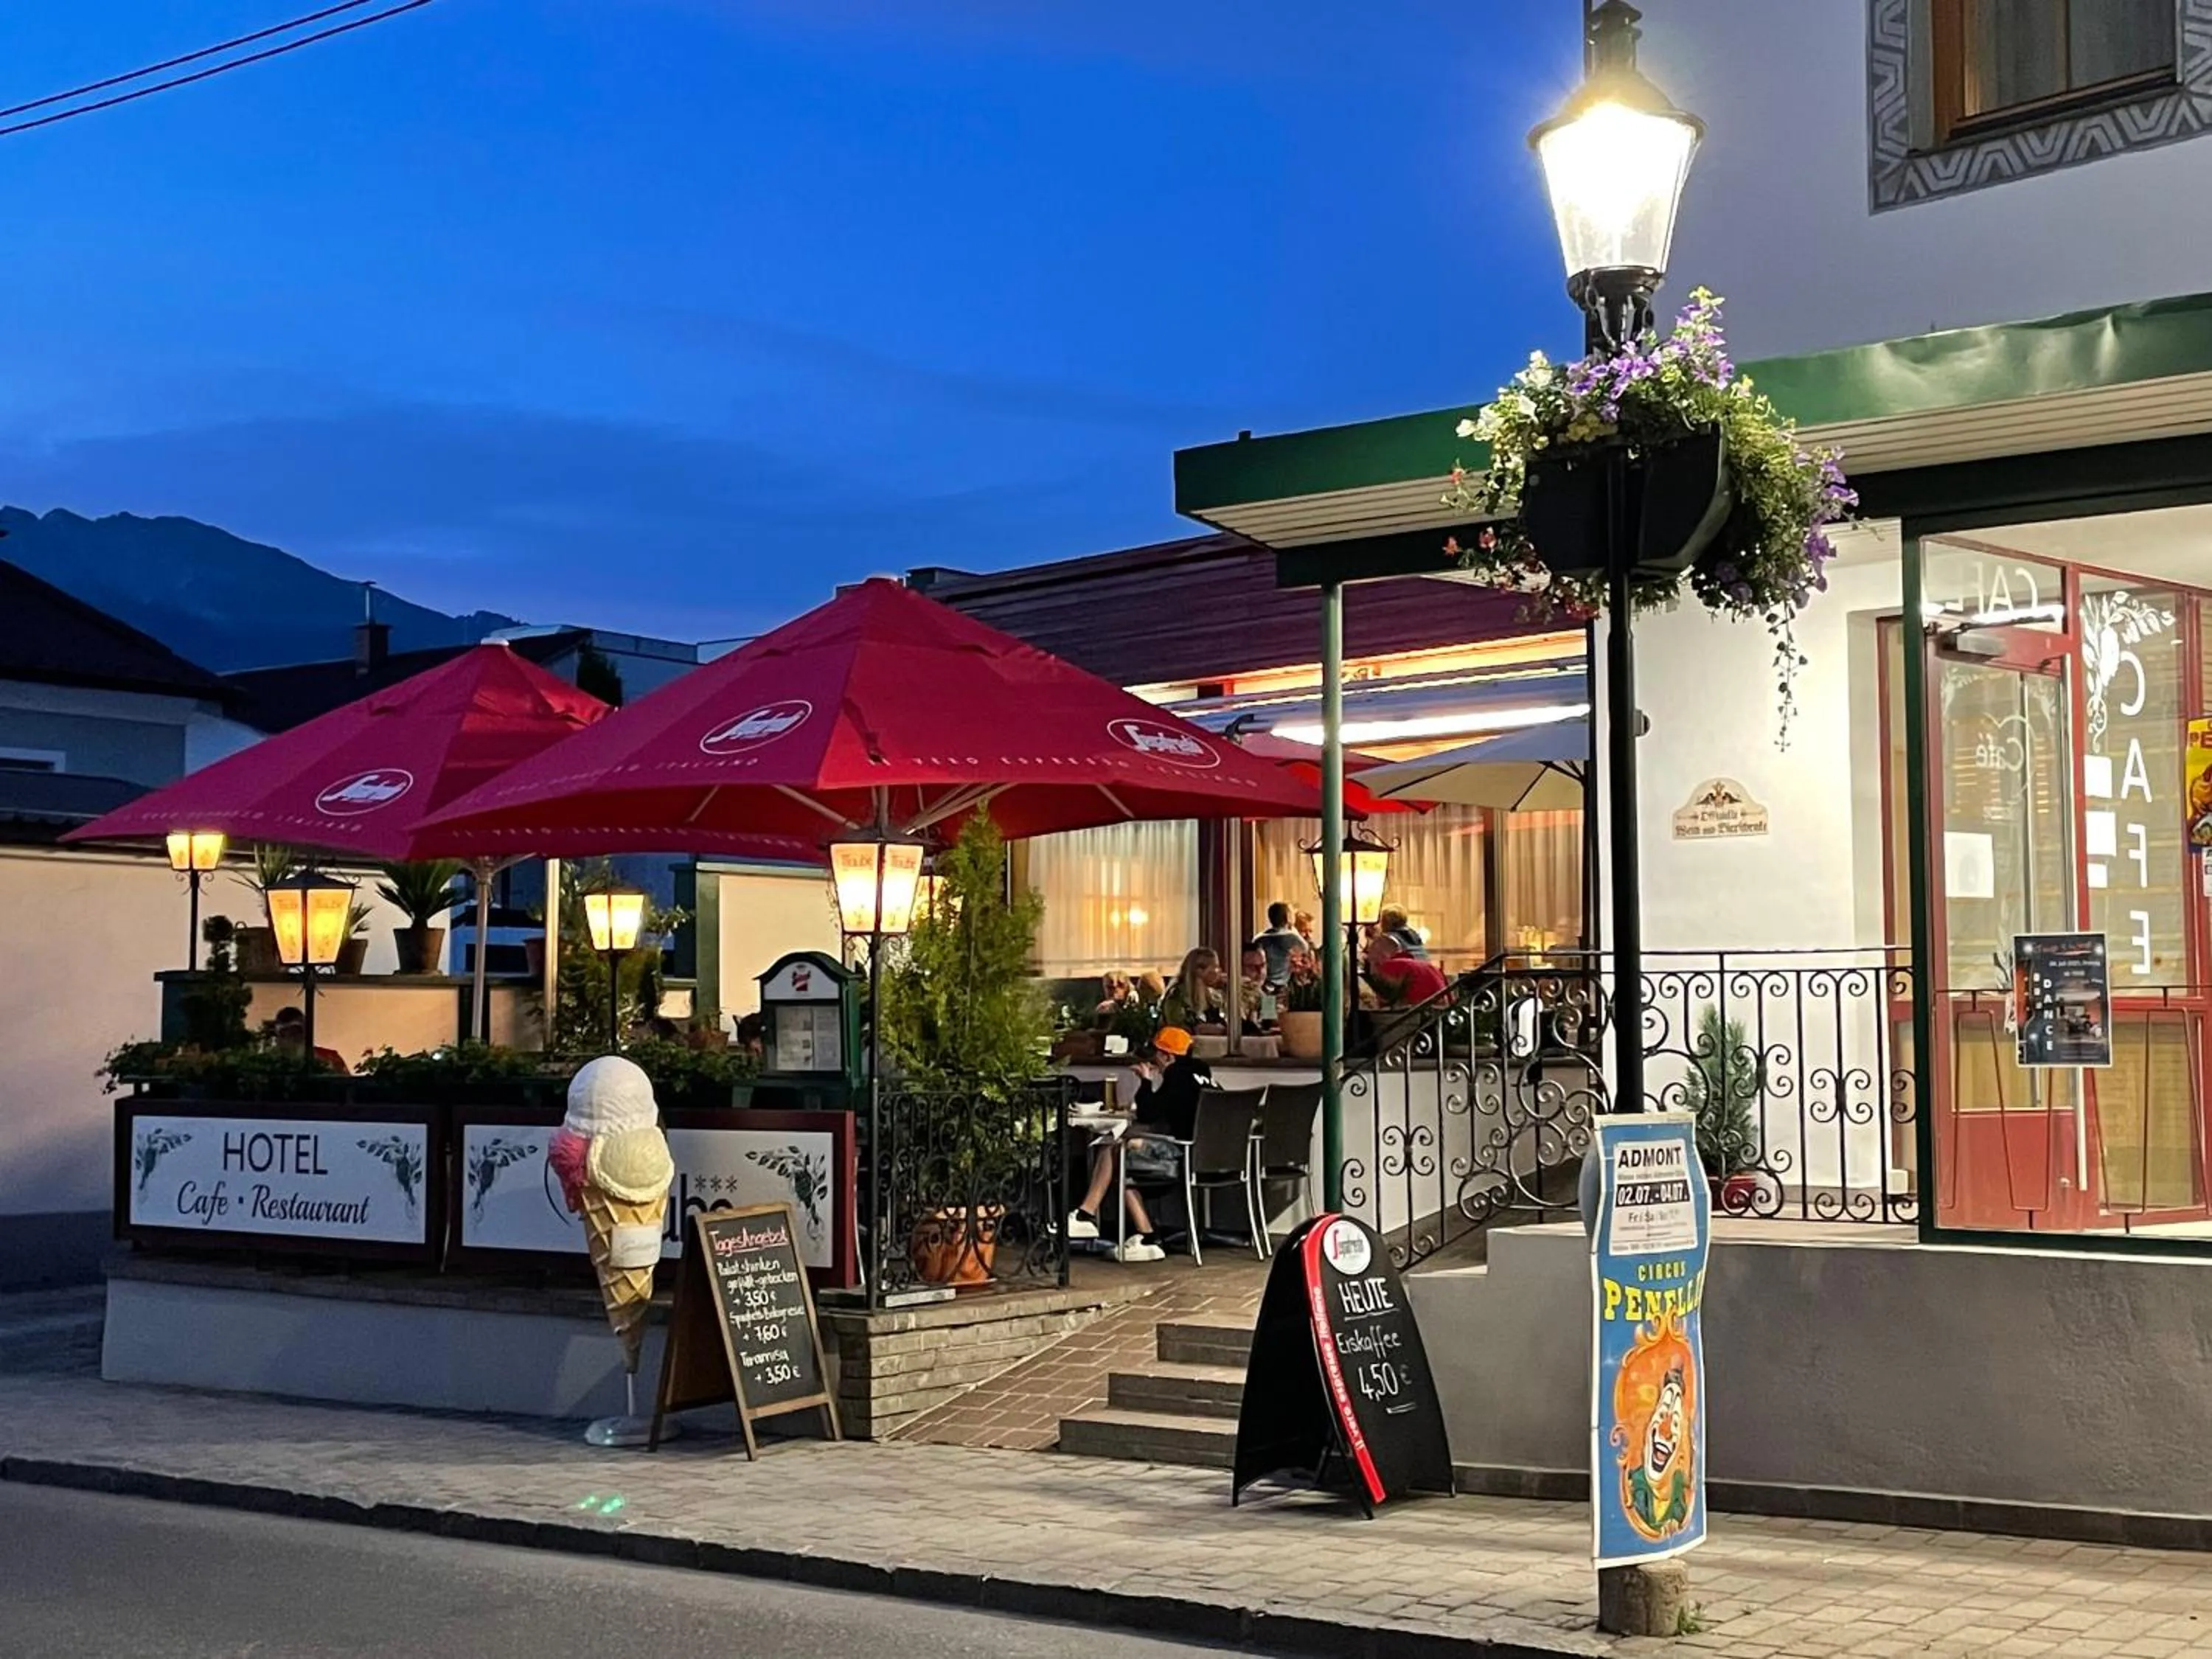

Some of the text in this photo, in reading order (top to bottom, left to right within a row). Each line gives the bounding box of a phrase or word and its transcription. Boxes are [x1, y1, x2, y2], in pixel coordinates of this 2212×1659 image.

[223, 1132, 329, 1175] HOTEL
[1618, 1146, 1682, 1169] ADMONT
[251, 1184, 371, 1224] Restaurant
[1638, 1260, 1686, 1282] CIRCUS
[1338, 1277, 1394, 1314] HEUTE
[1335, 1324, 1402, 1360] Eiskaffee
[765, 1364, 791, 1385] 3,50
[1357, 1363, 1399, 1402] 4,50
